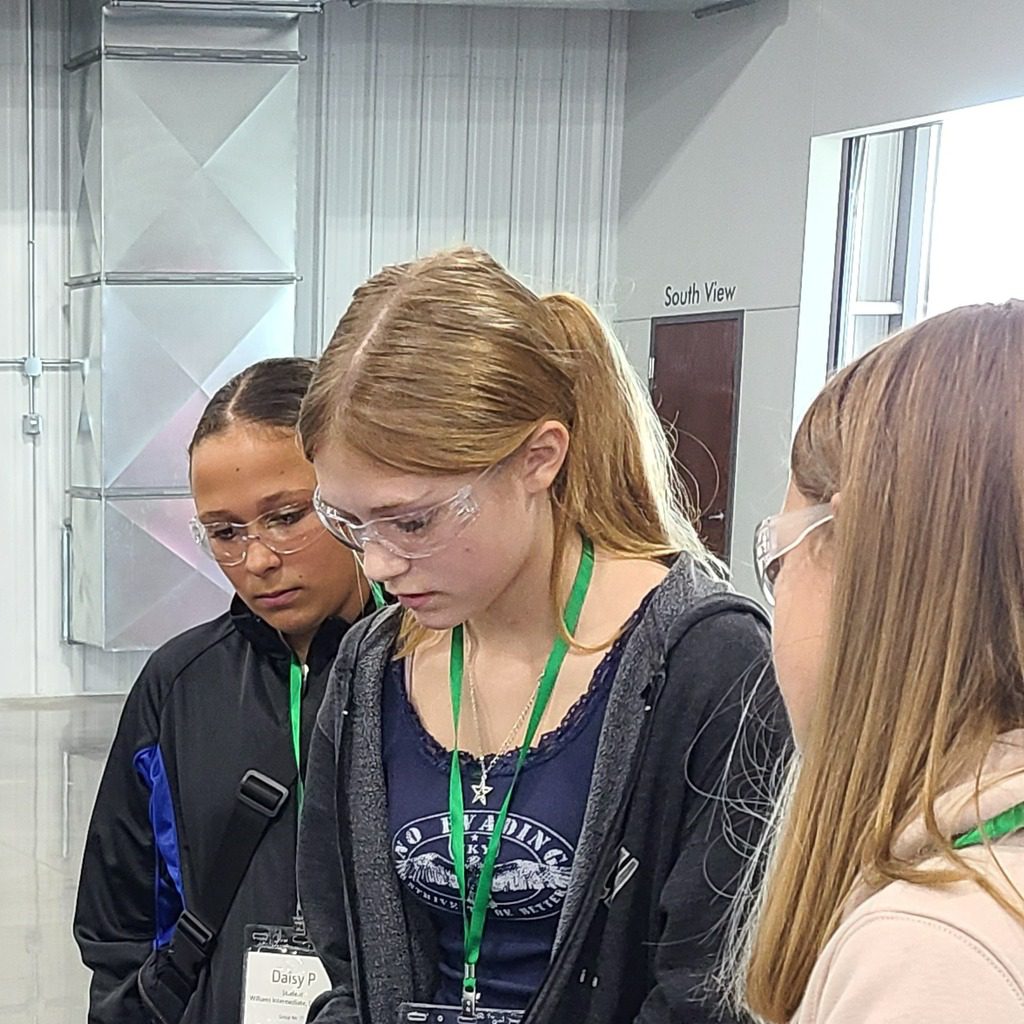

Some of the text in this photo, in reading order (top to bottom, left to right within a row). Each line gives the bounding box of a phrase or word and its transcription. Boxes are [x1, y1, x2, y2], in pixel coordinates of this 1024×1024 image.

[664, 280, 737, 307] South View
[395, 827, 422, 859] NO
[271, 969, 316, 989] Daisy P
